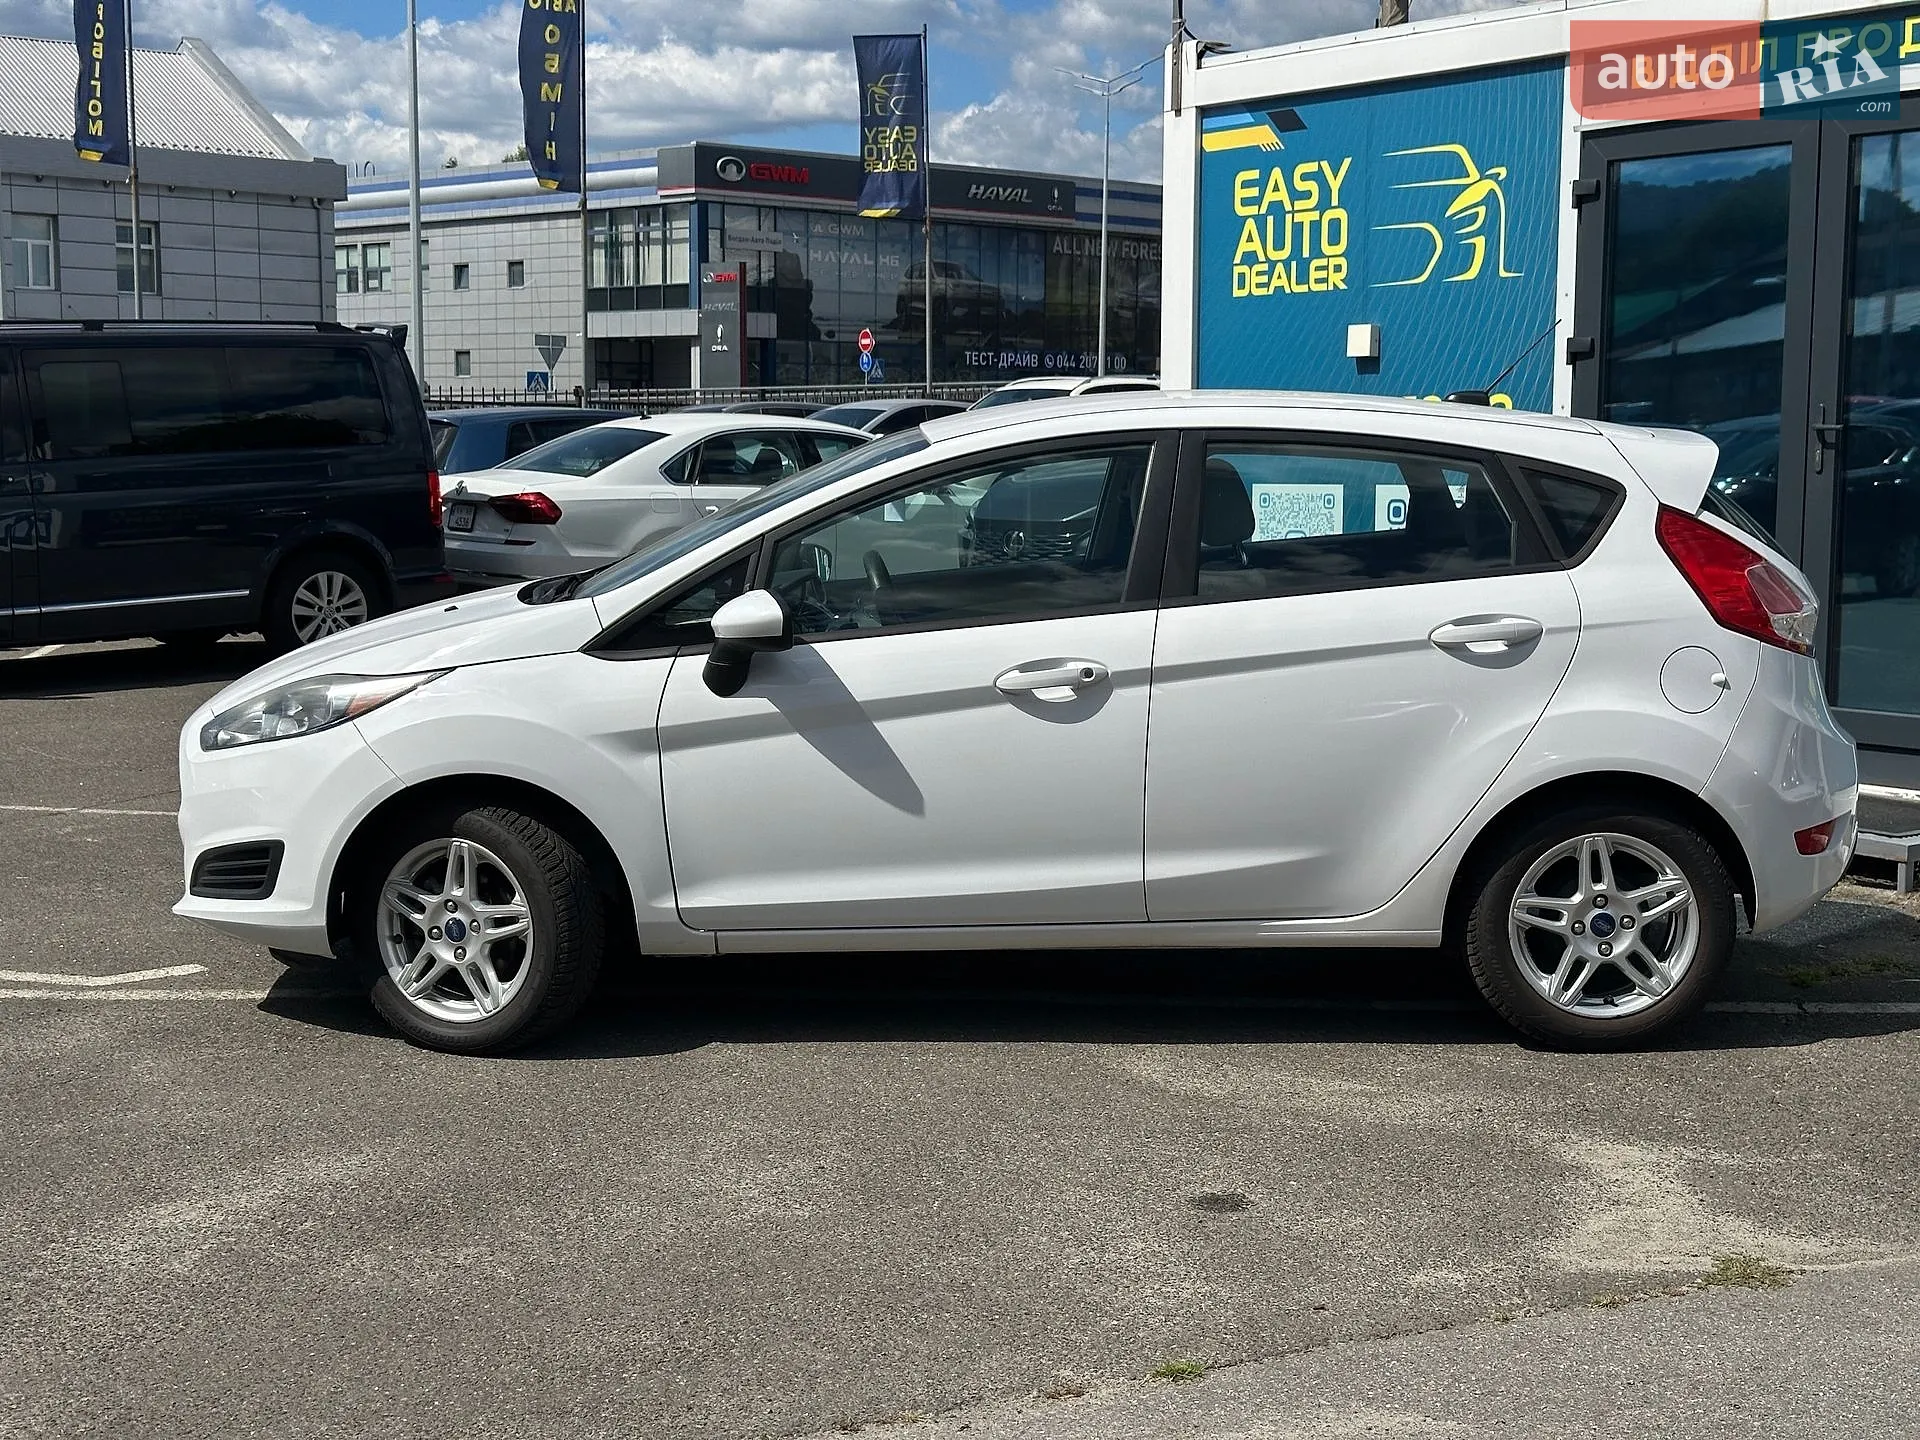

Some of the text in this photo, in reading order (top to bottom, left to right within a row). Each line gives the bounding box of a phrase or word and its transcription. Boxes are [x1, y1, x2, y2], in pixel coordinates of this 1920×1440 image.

[1631, 36, 1778, 89] ВДДІЛ
[750, 163, 809, 184] GWM
[967, 184, 1033, 203] HAVAL
[1234, 157, 1352, 217] EASY
[828, 223, 865, 237] GWM
[1233, 207, 1348, 265] AUTO
[1052, 234, 1081, 255] ALL
[809, 249, 873, 265] HAVAL
[1232, 256, 1348, 297] DEALER
[965, 351, 1038, 369] ТЕСТ-ДРАЙВ
[1056, 354, 1076, 368] 044
[1079, 355, 1098, 369] 207
[1114, 356, 1127, 370] 00
